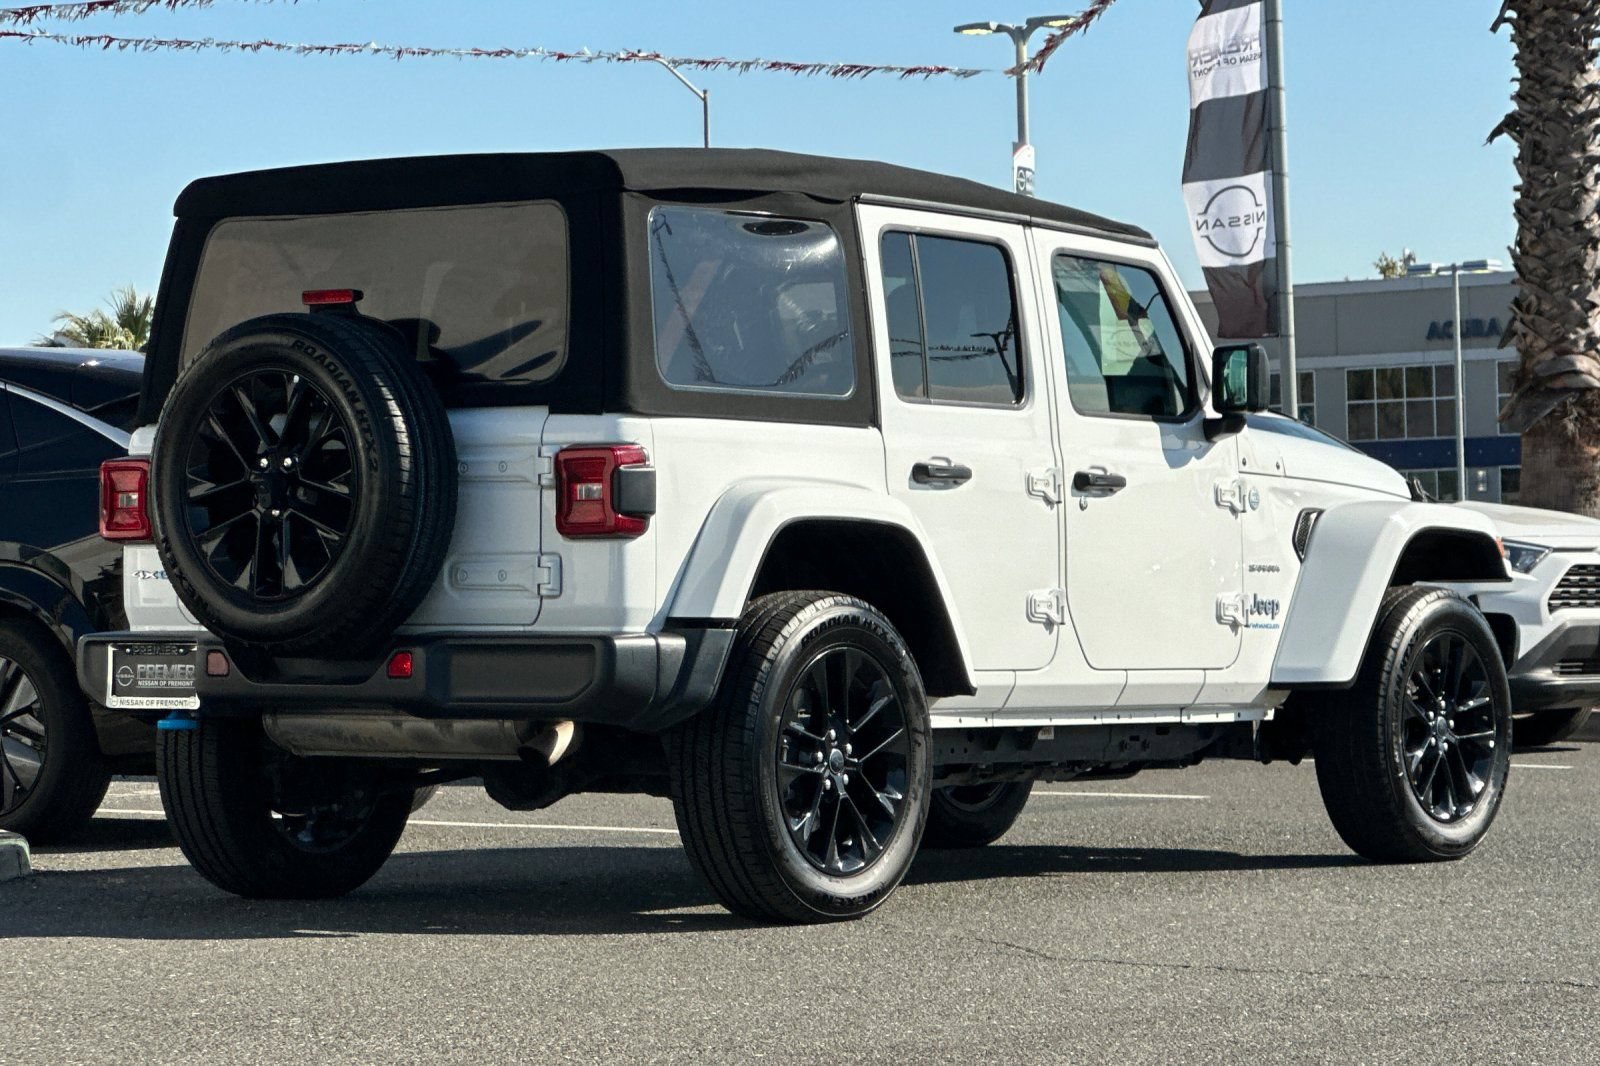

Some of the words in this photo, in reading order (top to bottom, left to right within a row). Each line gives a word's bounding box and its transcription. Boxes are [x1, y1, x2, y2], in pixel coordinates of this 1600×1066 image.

[1250, 593, 1280, 620] Jeep
[137, 664, 195, 679] PREMIER
[156, 699, 188, 707] FREMONT
